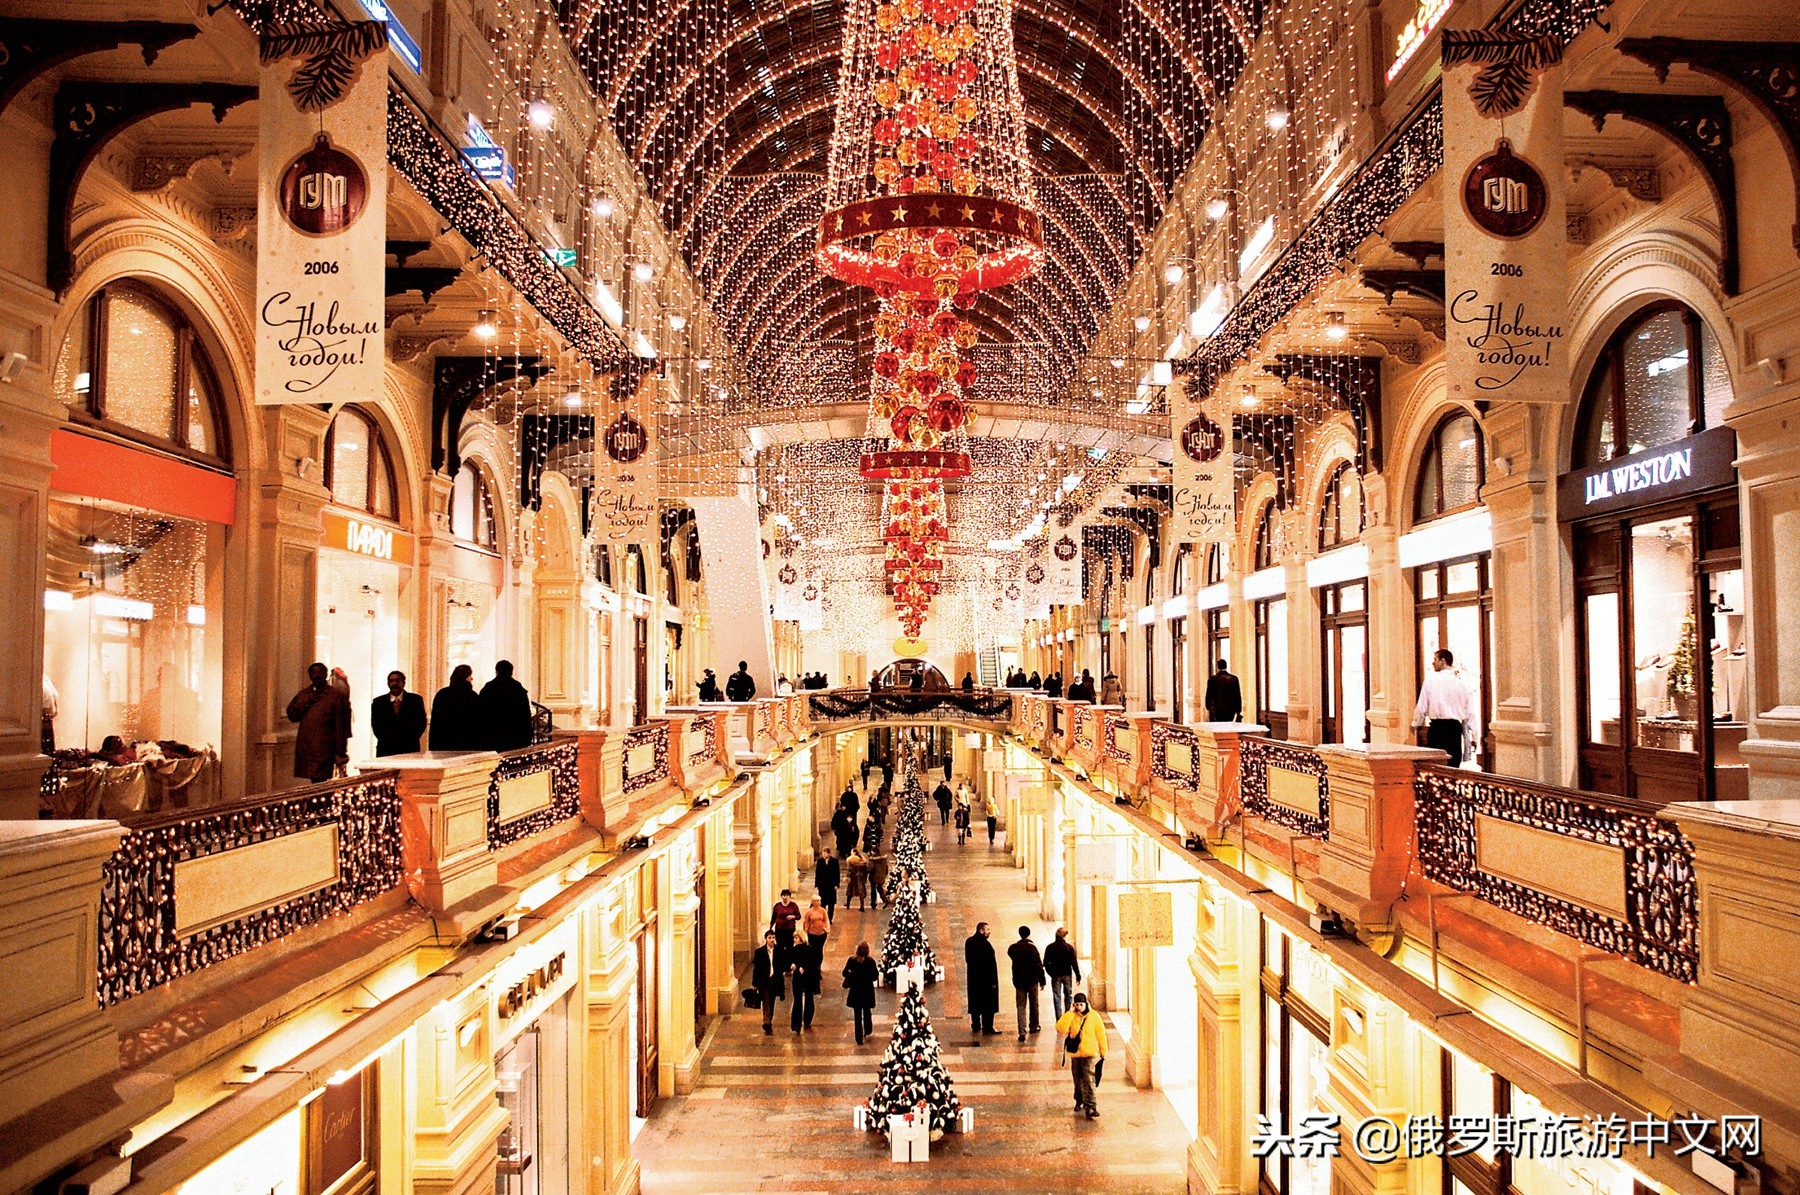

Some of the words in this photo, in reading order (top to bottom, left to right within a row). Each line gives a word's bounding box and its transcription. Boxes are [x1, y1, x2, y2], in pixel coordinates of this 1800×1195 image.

[299, 172, 347, 210] ГУМ
[1483, 177, 1528, 213] ГУМ
[304, 261, 339, 275] 2006
[1491, 263, 1523, 277] 2006
[262, 292, 300, 326] С
[288, 300, 379, 343] Новым
[1451, 290, 1490, 323] С
[1478, 303, 1563, 342] Новым
[283, 338, 366, 390] годом!
[1474, 342, 1550, 388] годом!
[1612, 448, 1692, 494] WESTON
